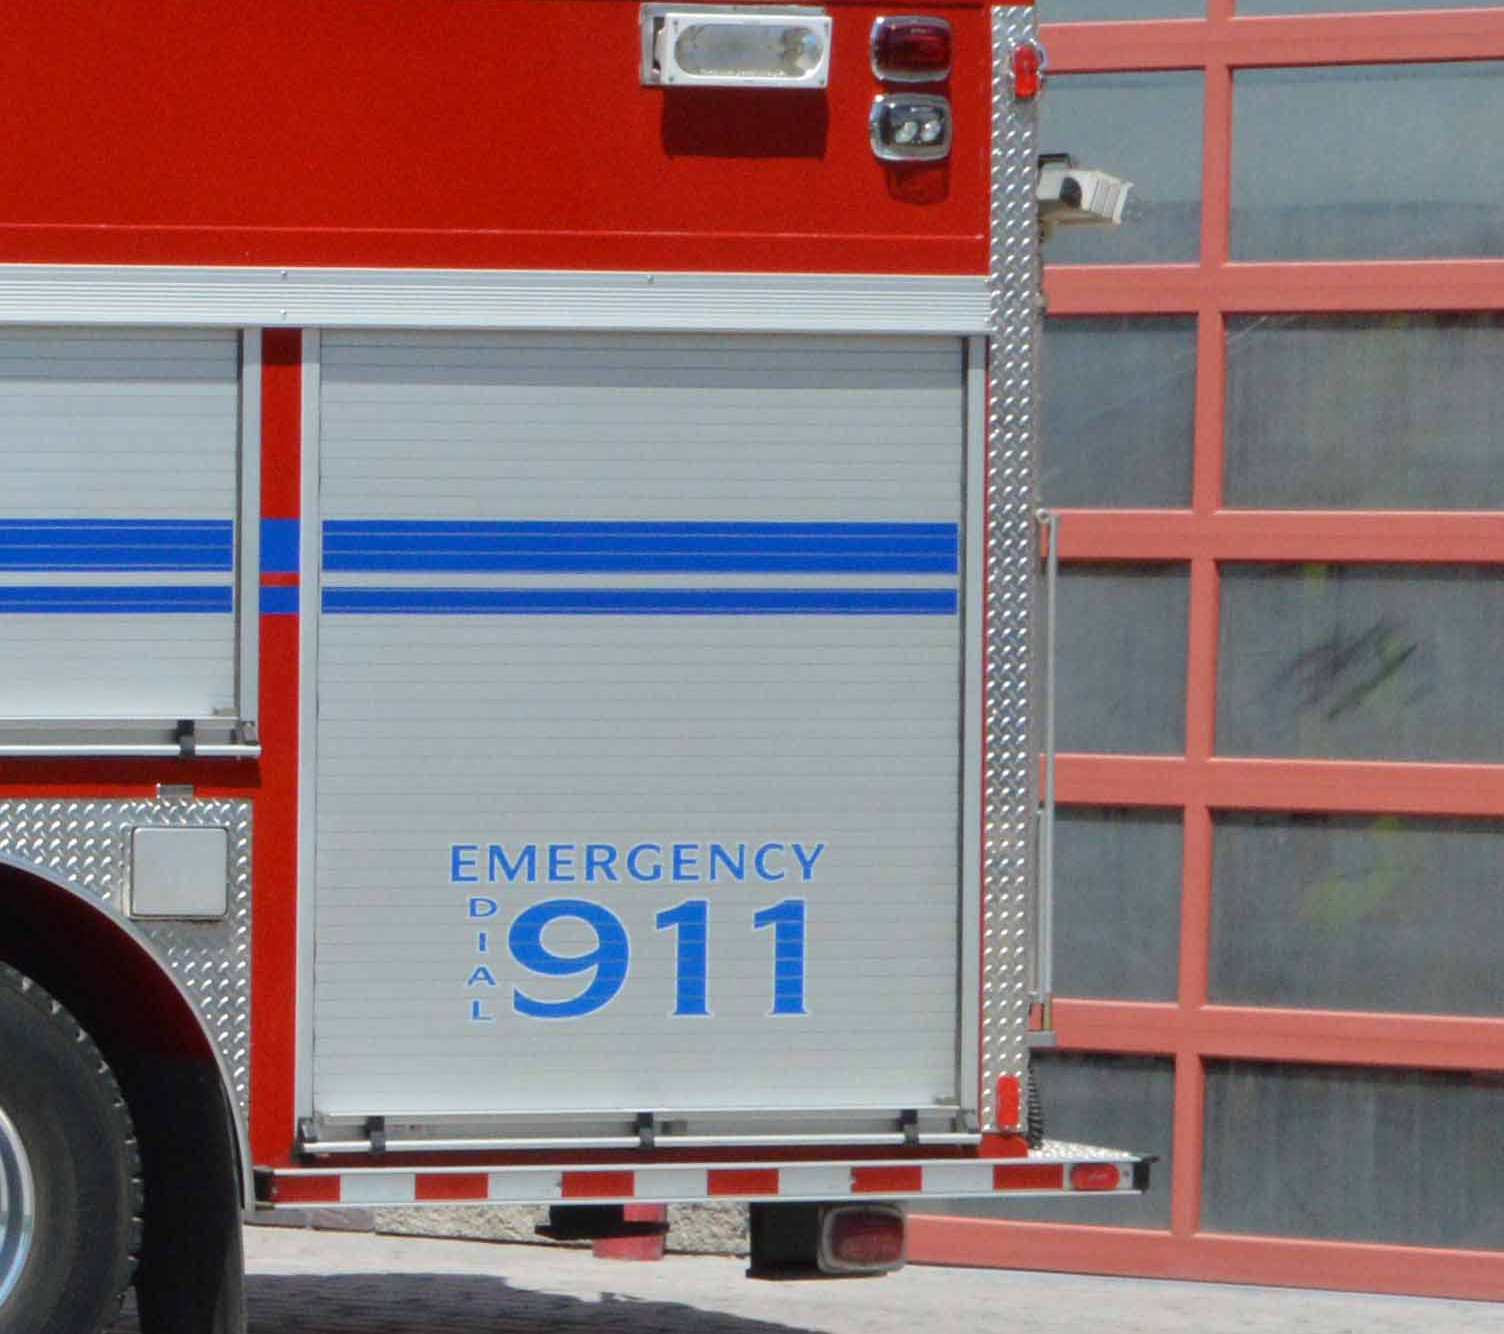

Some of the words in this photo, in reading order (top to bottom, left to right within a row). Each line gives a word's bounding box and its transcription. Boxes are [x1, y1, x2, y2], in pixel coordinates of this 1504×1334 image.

[450, 842, 826, 883] EMERGENCY
[467, 897, 499, 1022] DIAL
[507, 897, 809, 1018] 911
